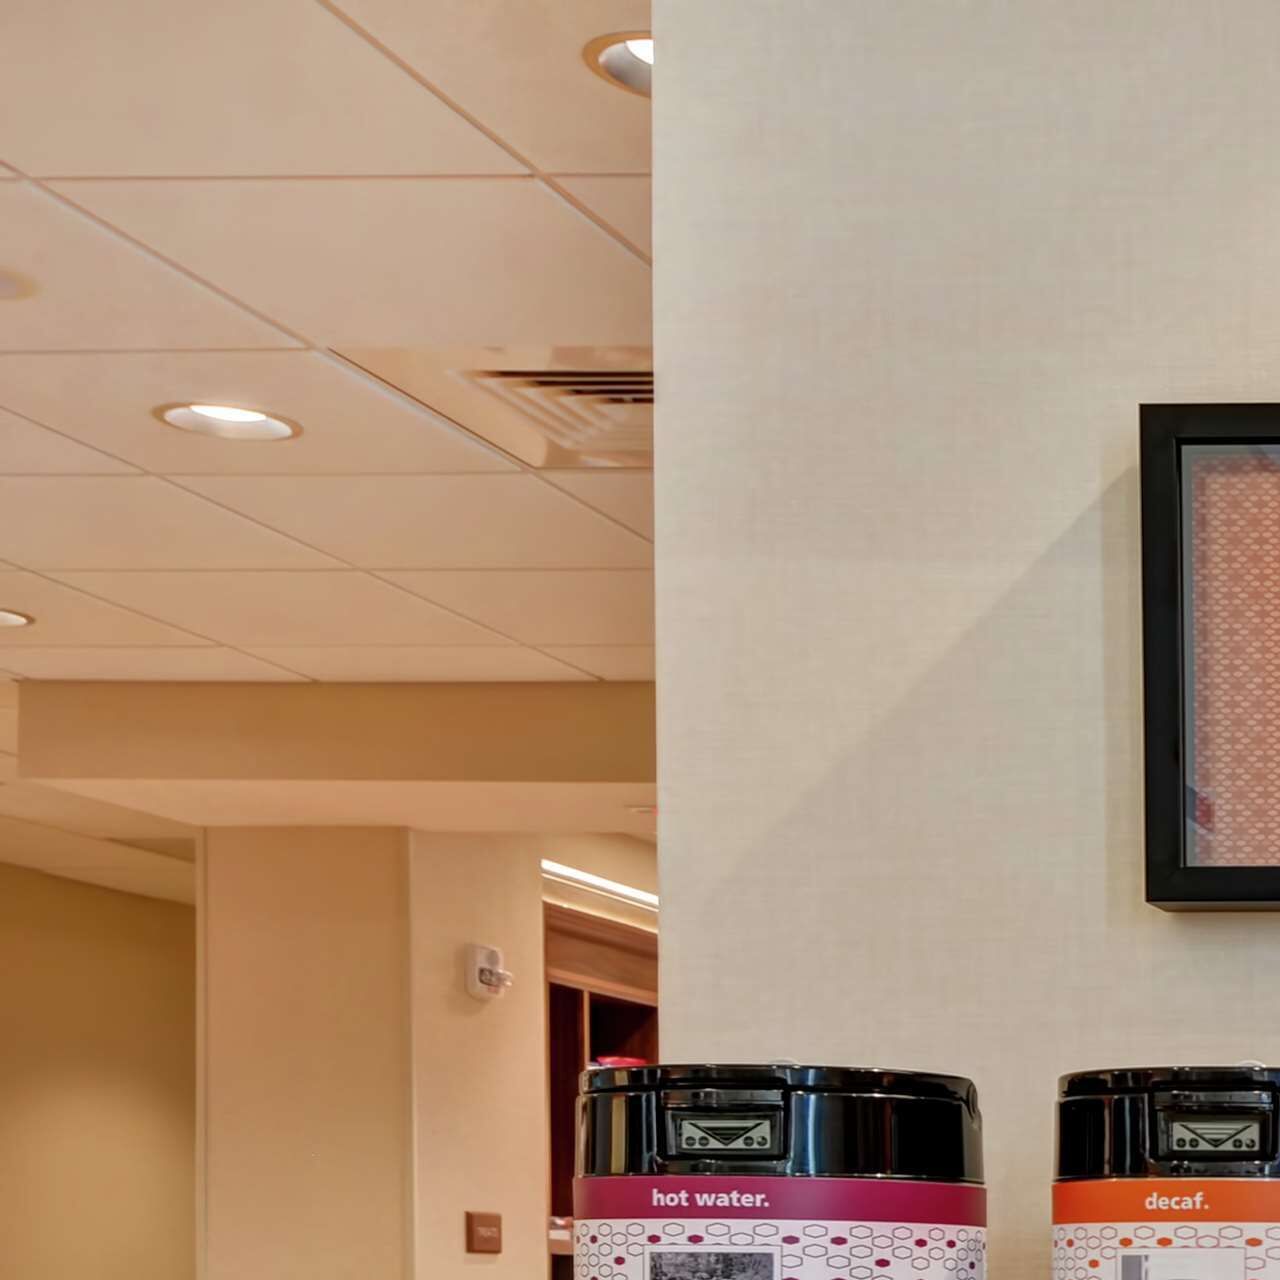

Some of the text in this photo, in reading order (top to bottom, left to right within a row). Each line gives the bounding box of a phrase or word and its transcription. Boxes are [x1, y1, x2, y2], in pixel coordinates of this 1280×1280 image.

[652, 1188, 770, 1208] hot water.
[1144, 1191, 1210, 1210] decaf.
